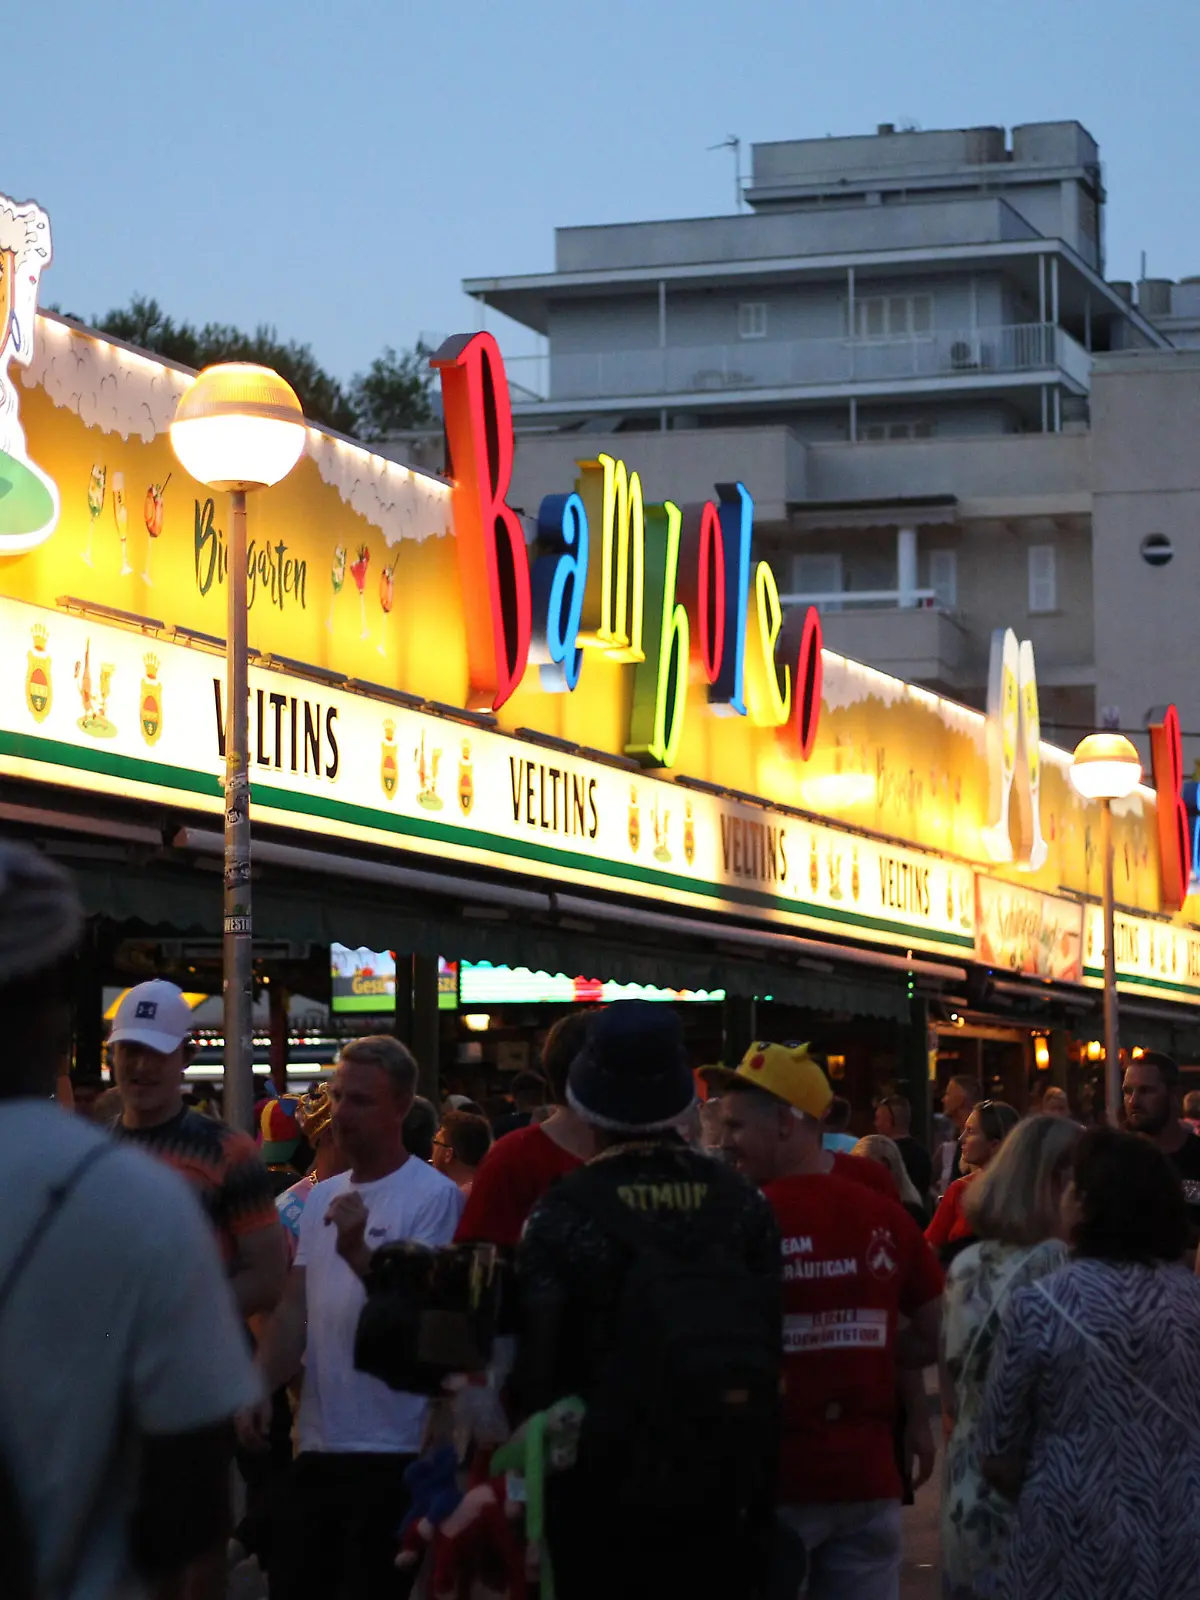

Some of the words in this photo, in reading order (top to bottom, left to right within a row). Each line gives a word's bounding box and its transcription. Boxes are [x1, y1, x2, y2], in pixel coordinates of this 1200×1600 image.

[194, 497, 307, 611] Bigarten
[430, 331, 823, 768] Bamboleo
[213, 678, 339, 779] VLTINS
[509, 756, 598, 839] VELTINS
[720, 813, 787, 881] VELTINS
[879, 856, 930, 915] VELTINS
[780, 1235, 814, 1256] EAM
[783, 1256, 857, 1280] RÄUTIGAM
